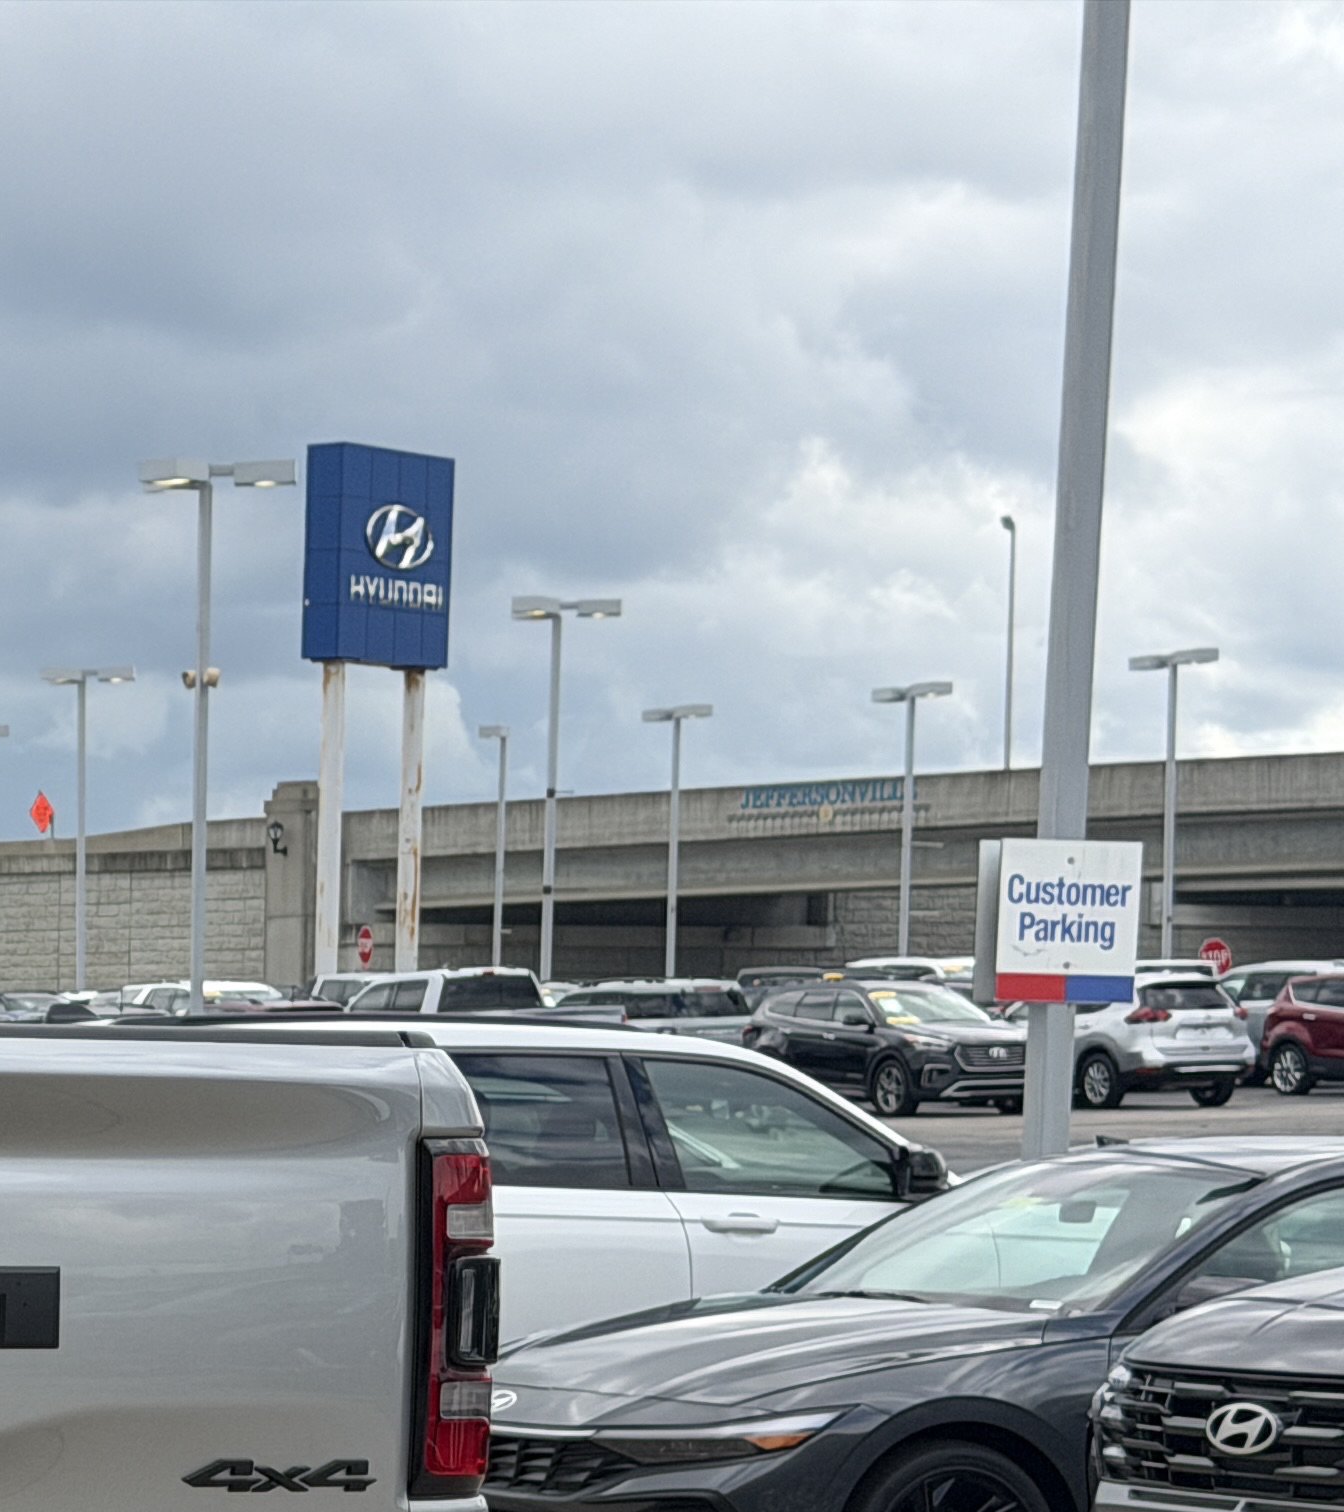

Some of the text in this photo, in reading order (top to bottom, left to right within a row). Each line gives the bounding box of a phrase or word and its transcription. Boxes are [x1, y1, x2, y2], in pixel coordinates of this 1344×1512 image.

[350, 574, 443, 609] HYUNDAI
[1007, 873, 1133, 907] Customer
[1018, 911, 1116, 951] Parking
[181, 1459, 377, 1492] 4x4
